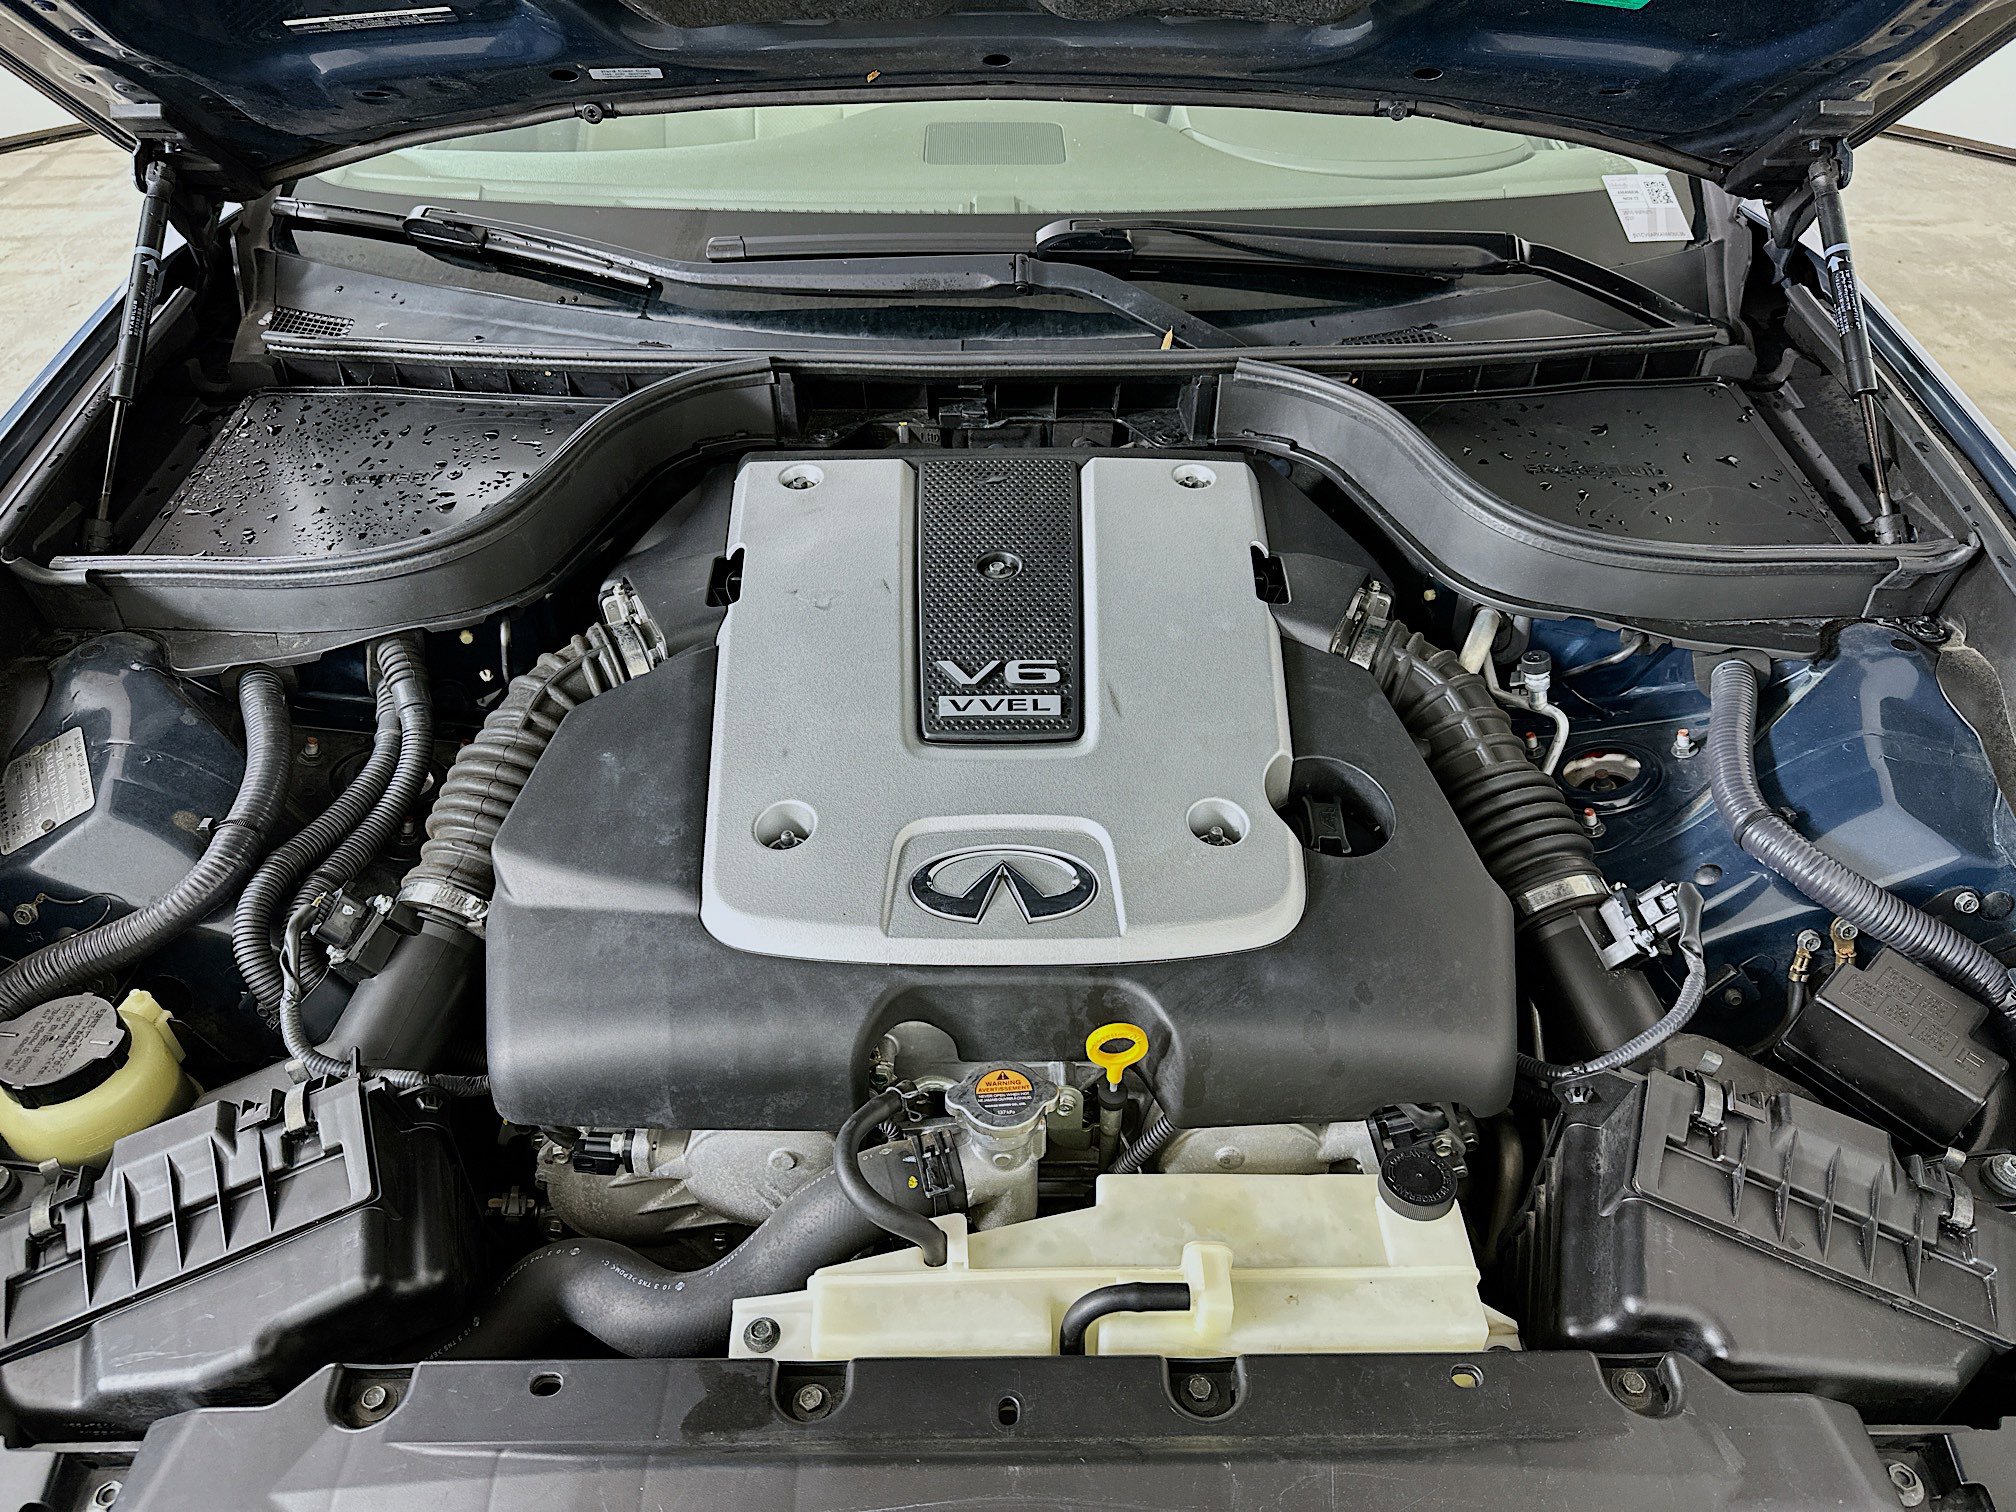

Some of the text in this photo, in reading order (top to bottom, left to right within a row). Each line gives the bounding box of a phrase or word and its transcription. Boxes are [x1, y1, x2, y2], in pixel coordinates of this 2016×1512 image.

[128, 300, 138, 335] STABILUS
[936, 659, 1061, 687] V6
[948, 698, 1052, 712] VVEL
